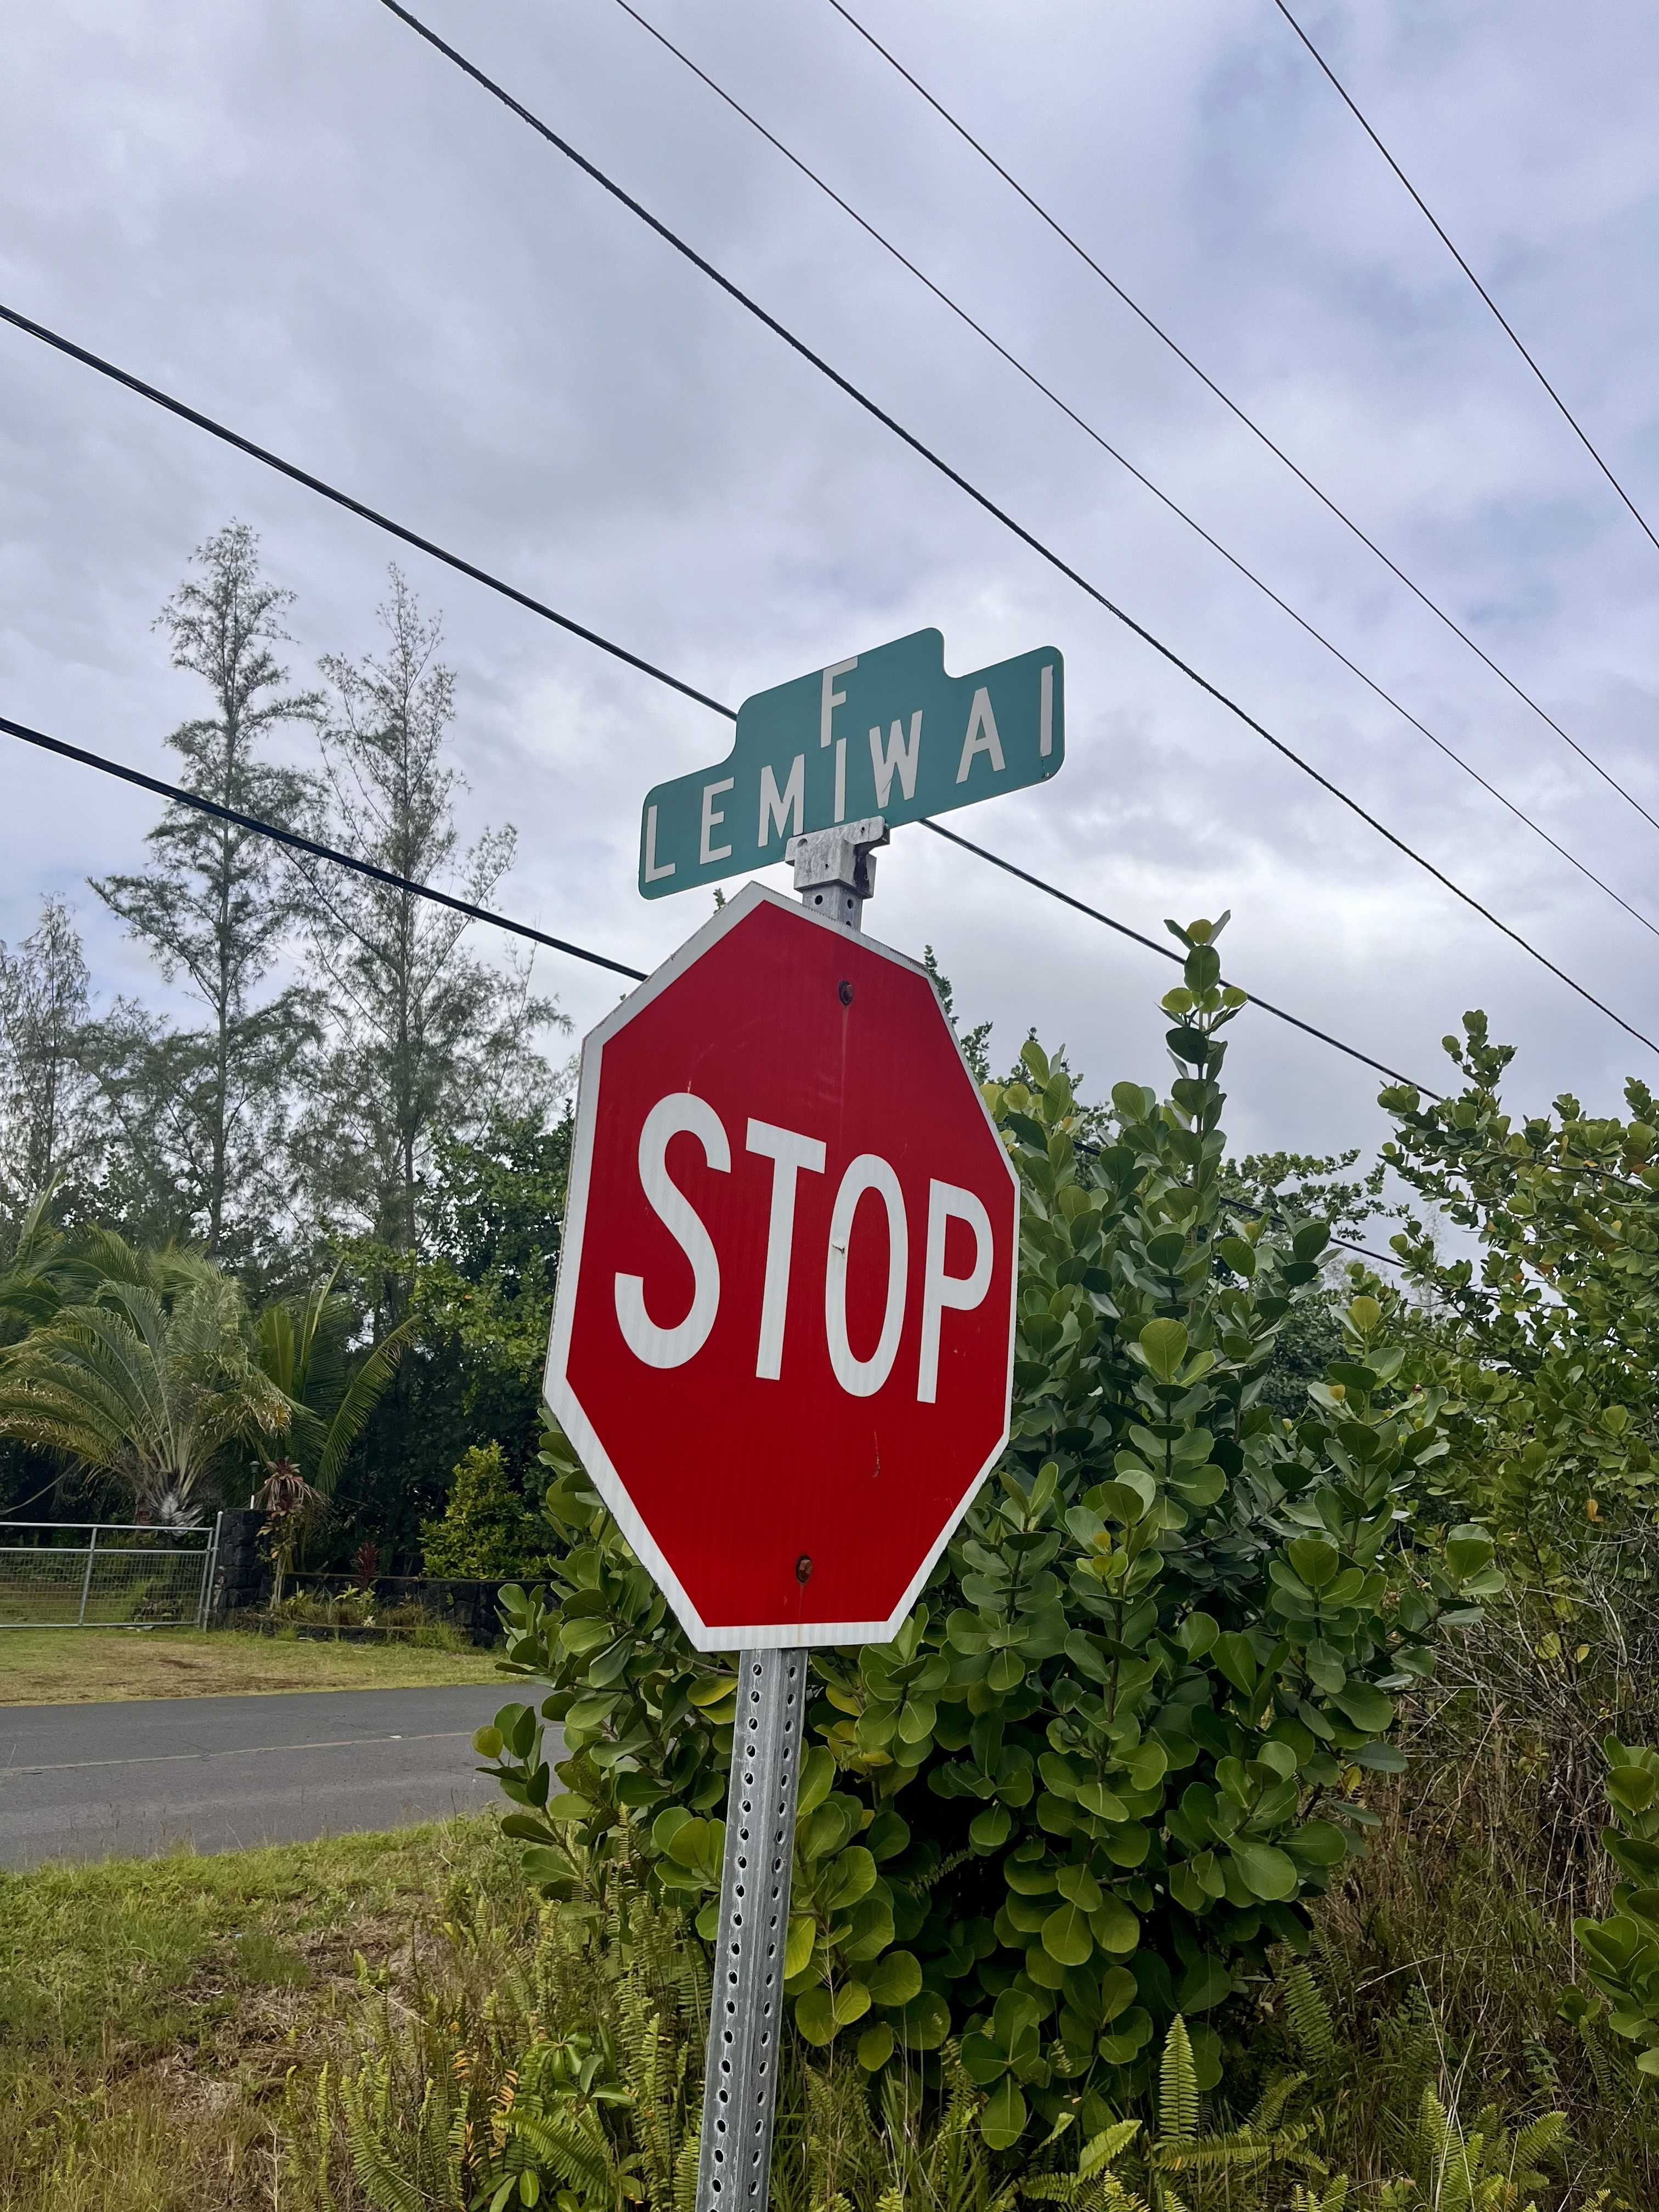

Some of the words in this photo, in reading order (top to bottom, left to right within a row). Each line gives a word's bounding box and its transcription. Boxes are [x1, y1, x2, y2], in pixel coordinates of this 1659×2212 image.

[645, 664, 1053, 883] LEMIWAI
[821, 656, 858, 748] F
[614, 1093, 994, 1403] STOP
